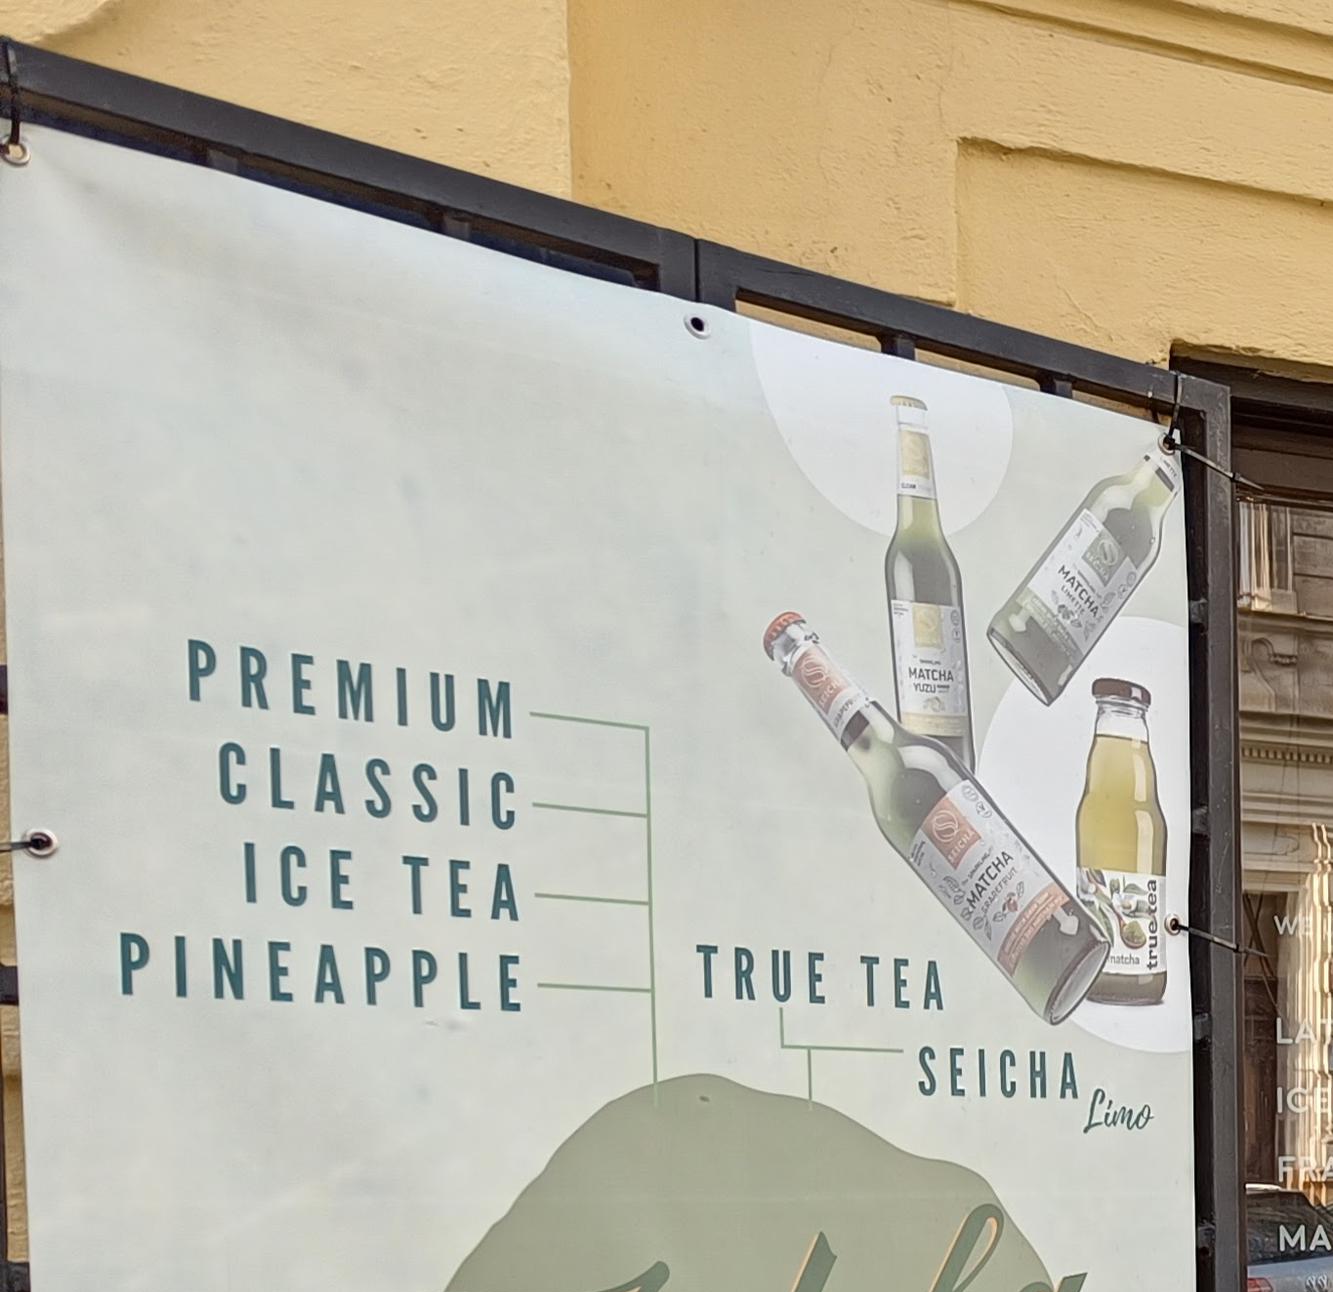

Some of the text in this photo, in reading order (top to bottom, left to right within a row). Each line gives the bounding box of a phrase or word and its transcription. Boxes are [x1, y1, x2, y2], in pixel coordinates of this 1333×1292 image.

[1058, 565, 1099, 617] MATCHA
[187, 638, 512, 739] PREMIUM
[908, 667, 954, 682] MATCHA
[913, 683, 936, 693] YUZU
[218, 741, 515, 830] CLASSIC
[243, 842, 519, 921] ICE TEA
[967, 851, 1014, 909] MATCHA
[1147, 880, 1158, 970] true tea
[1274, 915, 1313, 936] WE
[119, 932, 521, 1012] PINEAPPLE
[697, 945, 944, 1011] TRUE TEA
[917, 1046, 1154, 1134] SEICHA Limo
[1276, 1087, 1331, 1114] ICE
